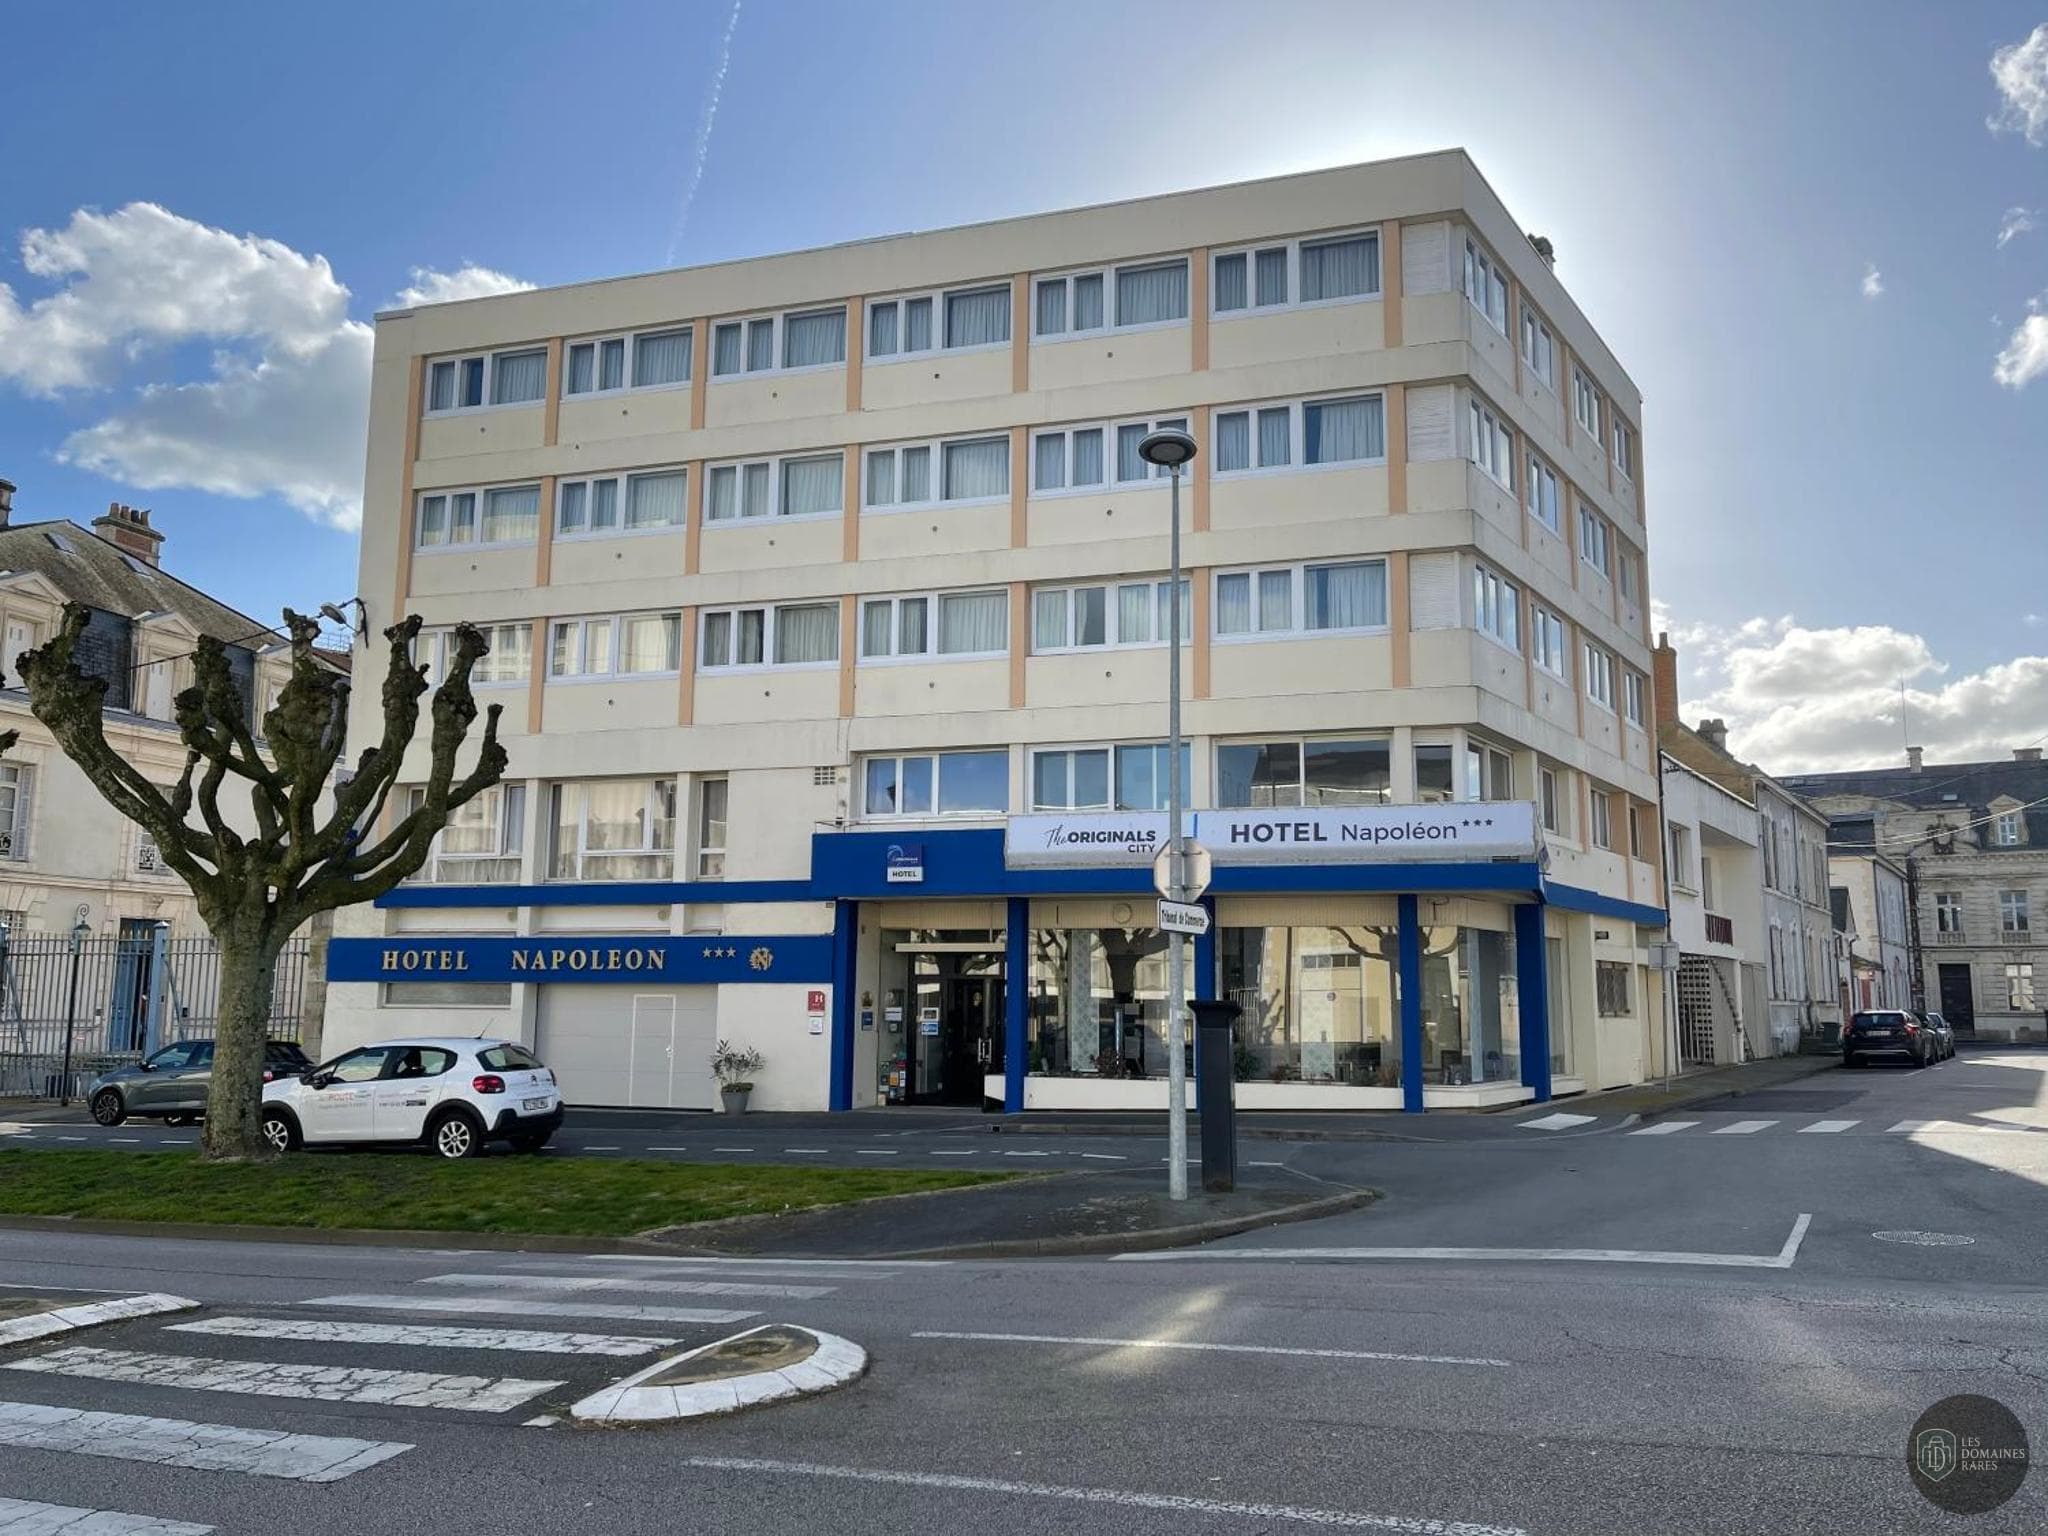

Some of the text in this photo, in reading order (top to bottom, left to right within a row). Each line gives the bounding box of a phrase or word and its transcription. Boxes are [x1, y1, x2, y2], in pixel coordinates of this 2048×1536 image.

[1045, 824, 1156, 848] The ORIGINALS
[1231, 821, 1458, 844] HOTEL Napoléon
[1128, 844, 1156, 853] CITY
[892, 870, 917, 878] HOTEL
[381, 948, 667, 972] HOTEL NAPOLEON
